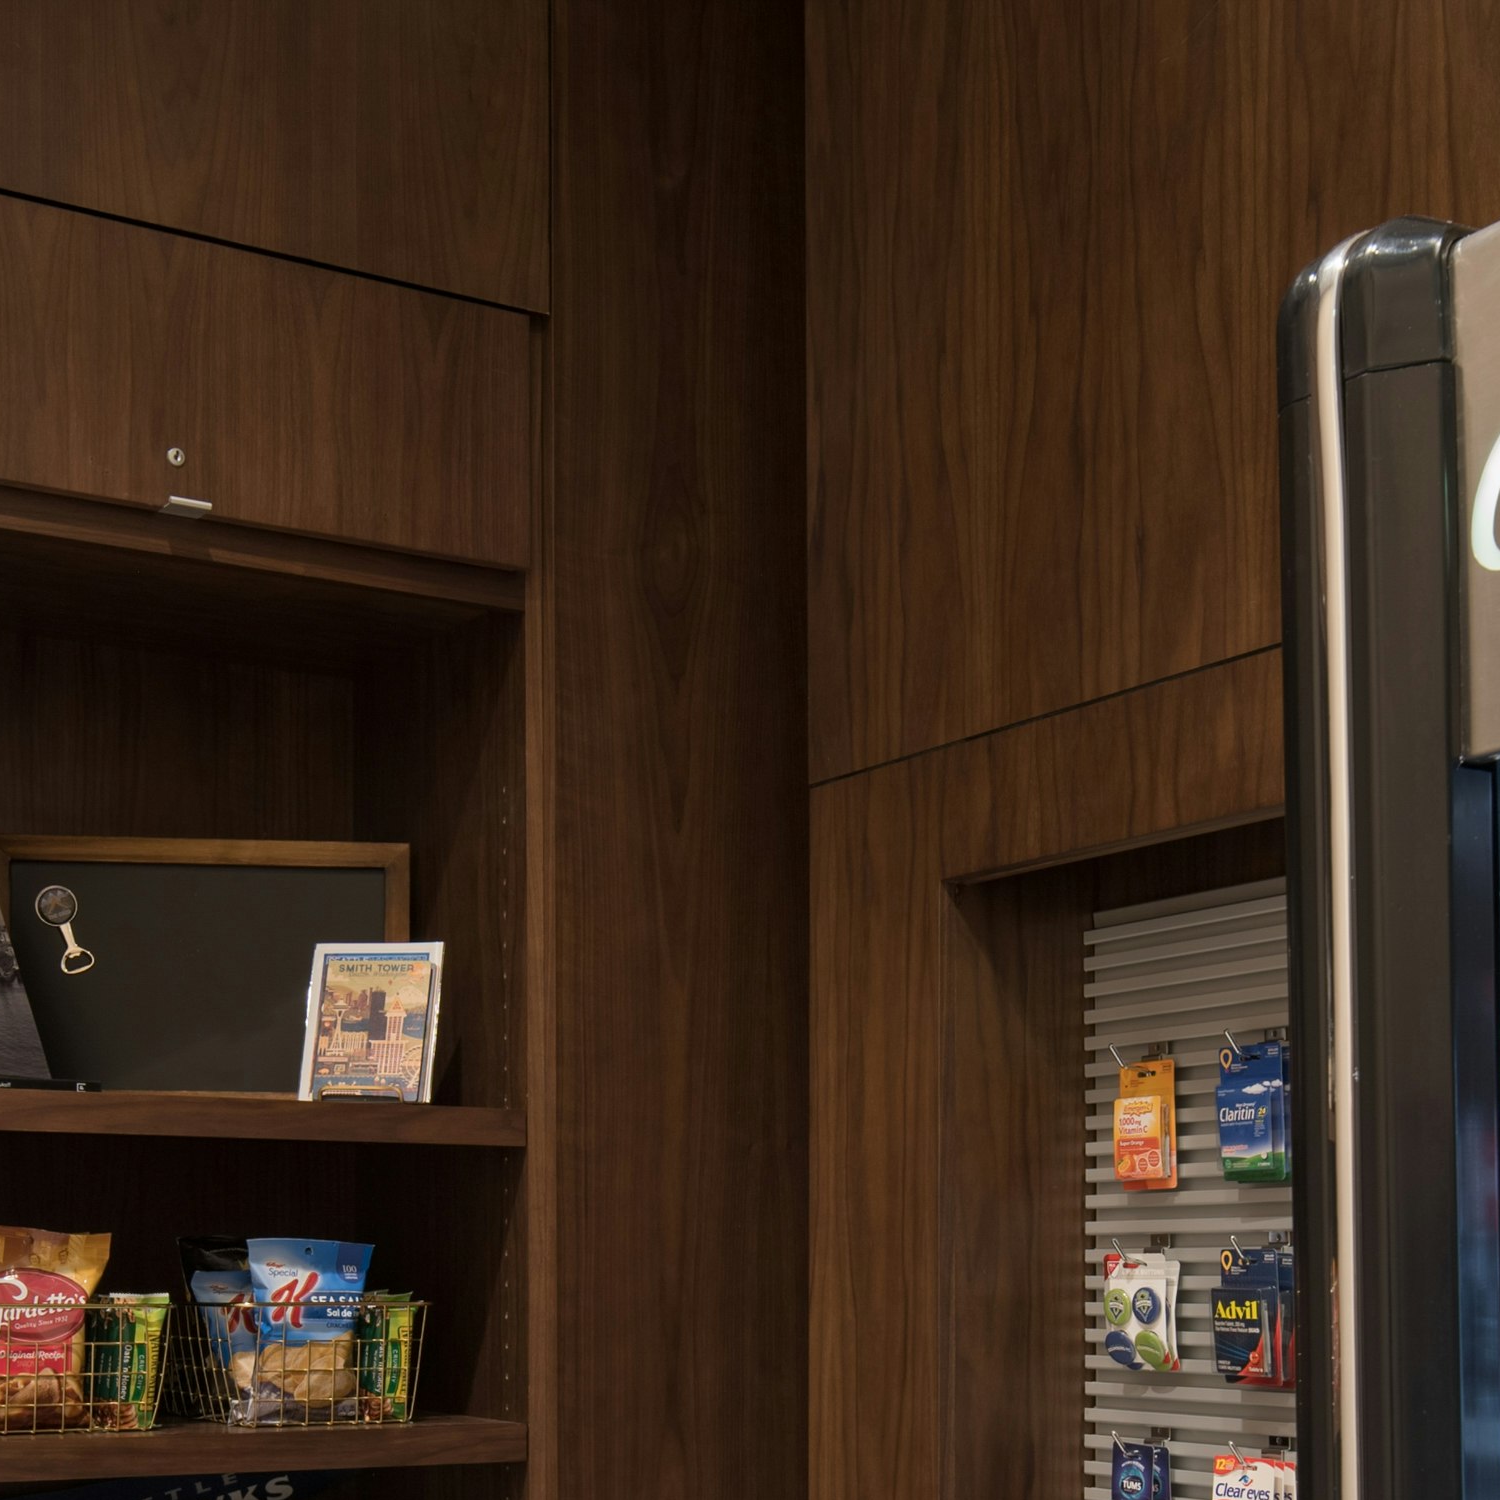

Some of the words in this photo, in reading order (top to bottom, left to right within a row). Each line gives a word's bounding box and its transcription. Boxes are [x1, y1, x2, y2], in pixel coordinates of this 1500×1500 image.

[339, 964, 372, 973] SMITH
[378, 964, 414, 972] TOWER
[1220, 1107, 1255, 1122] Claritin
[1119, 1127, 1142, 1135] Vitamin
[268, 1268, 298, 1277] Special
[342, 1264, 357, 1273] 100
[270, 1271, 320, 1329] K
[341, 1309, 352, 1317] de
[1214, 1300, 1259, 1320] Advil
[14, 1322, 37, 1330] Quality
[38, 1319, 53, 1327] Since
[123, 1344, 133, 1363] Oats
[148, 1334, 161, 1374] NATURE
[136, 1354, 145, 1390] CRUCHY
[119, 1375, 130, 1400] Honey
[1123, 1481, 1141, 1491] TUMS
[1215, 1483, 1245, 1498] Clear
